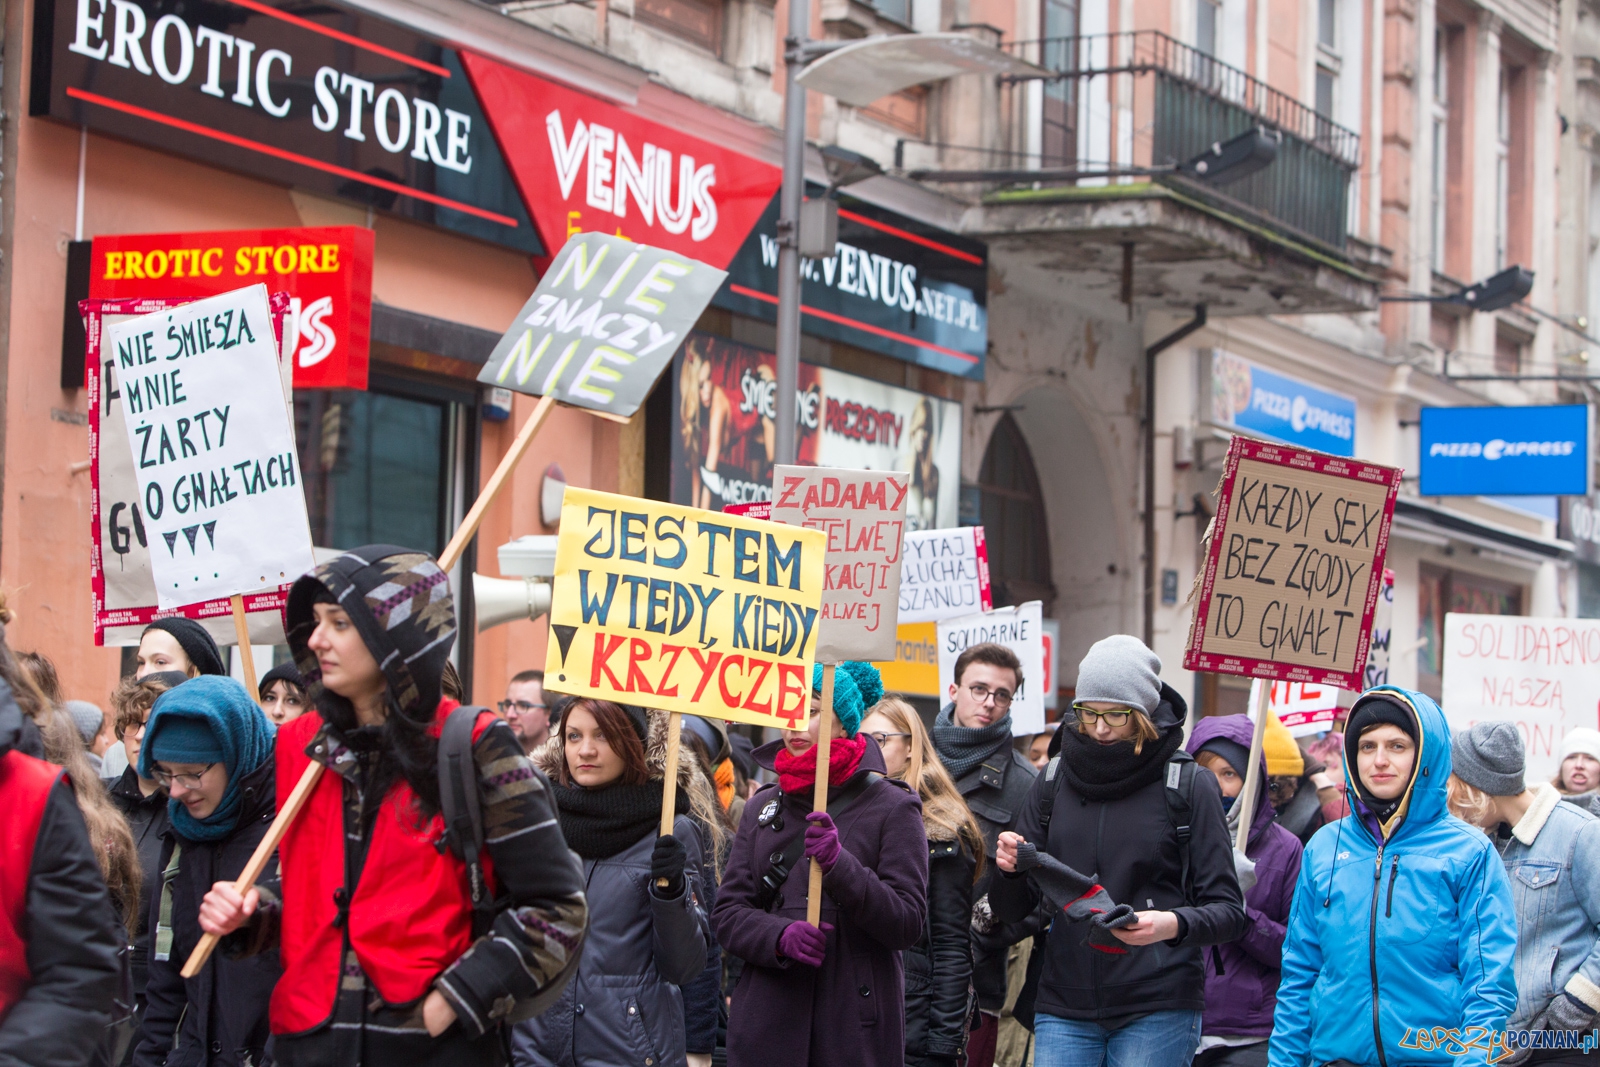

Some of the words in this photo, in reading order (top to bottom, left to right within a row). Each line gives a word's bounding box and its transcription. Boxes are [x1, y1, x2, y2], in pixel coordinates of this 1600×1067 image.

[69, 0, 292, 117] EROTIC
[313, 66, 471, 174] STORE
[546, 109, 718, 241] VENUS
[104, 248, 223, 280] EROTIC
[235, 244, 340, 275] STORE
[117, 331, 157, 370] NIE
[166, 308, 256, 362] ŚMIESZĄ
[524, 294, 677, 357] ZNACZY
[125, 369, 187, 414] MNIE
[496, 329, 638, 404] NIE
[135, 405, 231, 469] ŻARTY
[145, 481, 164, 521] O
[173, 452, 296, 515] GWAŁTACH
[775, 476, 908, 517] ŻĄDAMY
[1235, 477, 1322, 537] KAŻDY
[1325, 497, 1379, 548] SEX
[583, 505, 804, 592] JESTEM
[1224, 533, 1280, 586] BEZ
[1285, 543, 1365, 607] ZGODY
[578, 569, 724, 650] WTEDY,
[1215, 593, 1244, 638] TO
[1259, 601, 1354, 663] GWAŁT
[589, 632, 807, 728] KRZYCZĘ
[1482, 676, 1566, 720] NASZĄ
